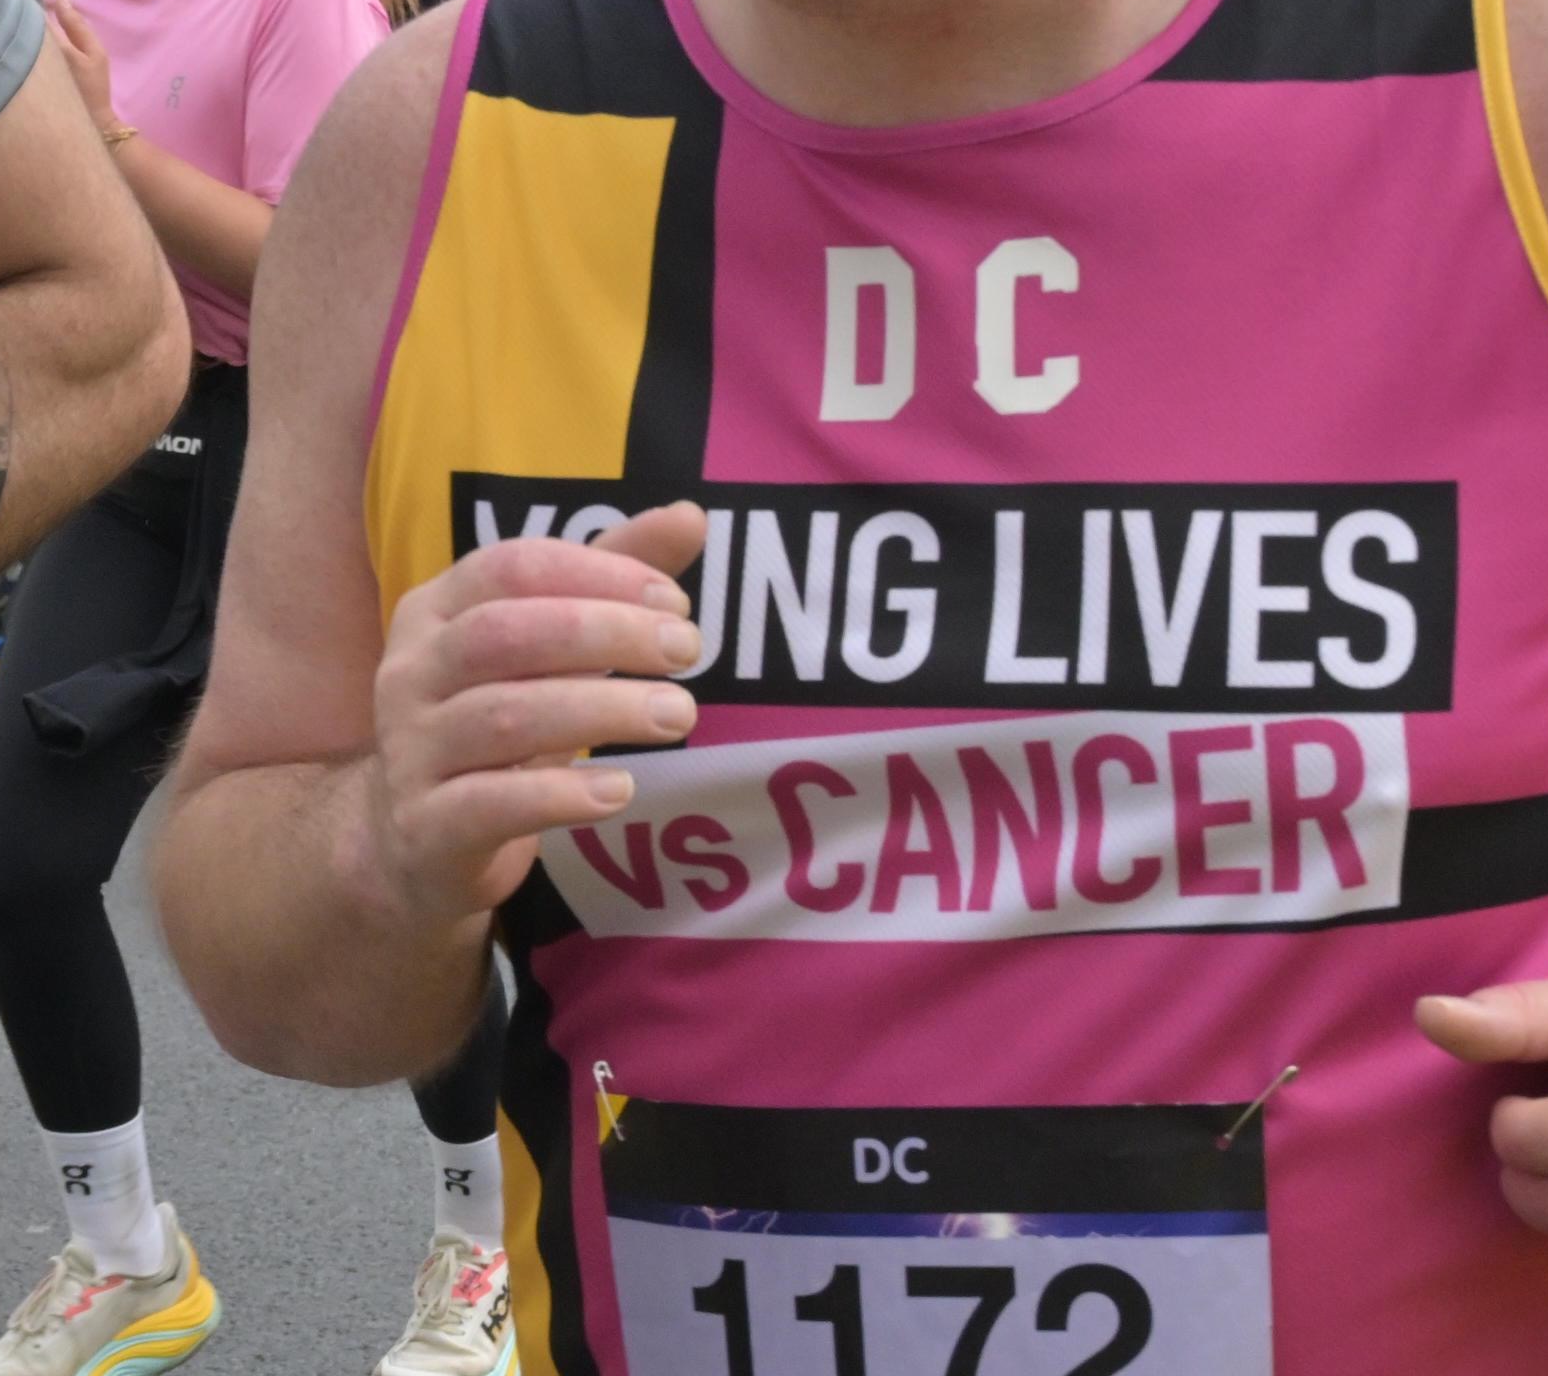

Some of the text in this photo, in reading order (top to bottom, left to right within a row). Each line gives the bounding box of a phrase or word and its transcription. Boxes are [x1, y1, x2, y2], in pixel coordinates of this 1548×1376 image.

[474, 500, 1418, 689] UNG LIVES
[765, 718, 1369, 915] CANCER
[853, 1137, 930, 1185] DC
